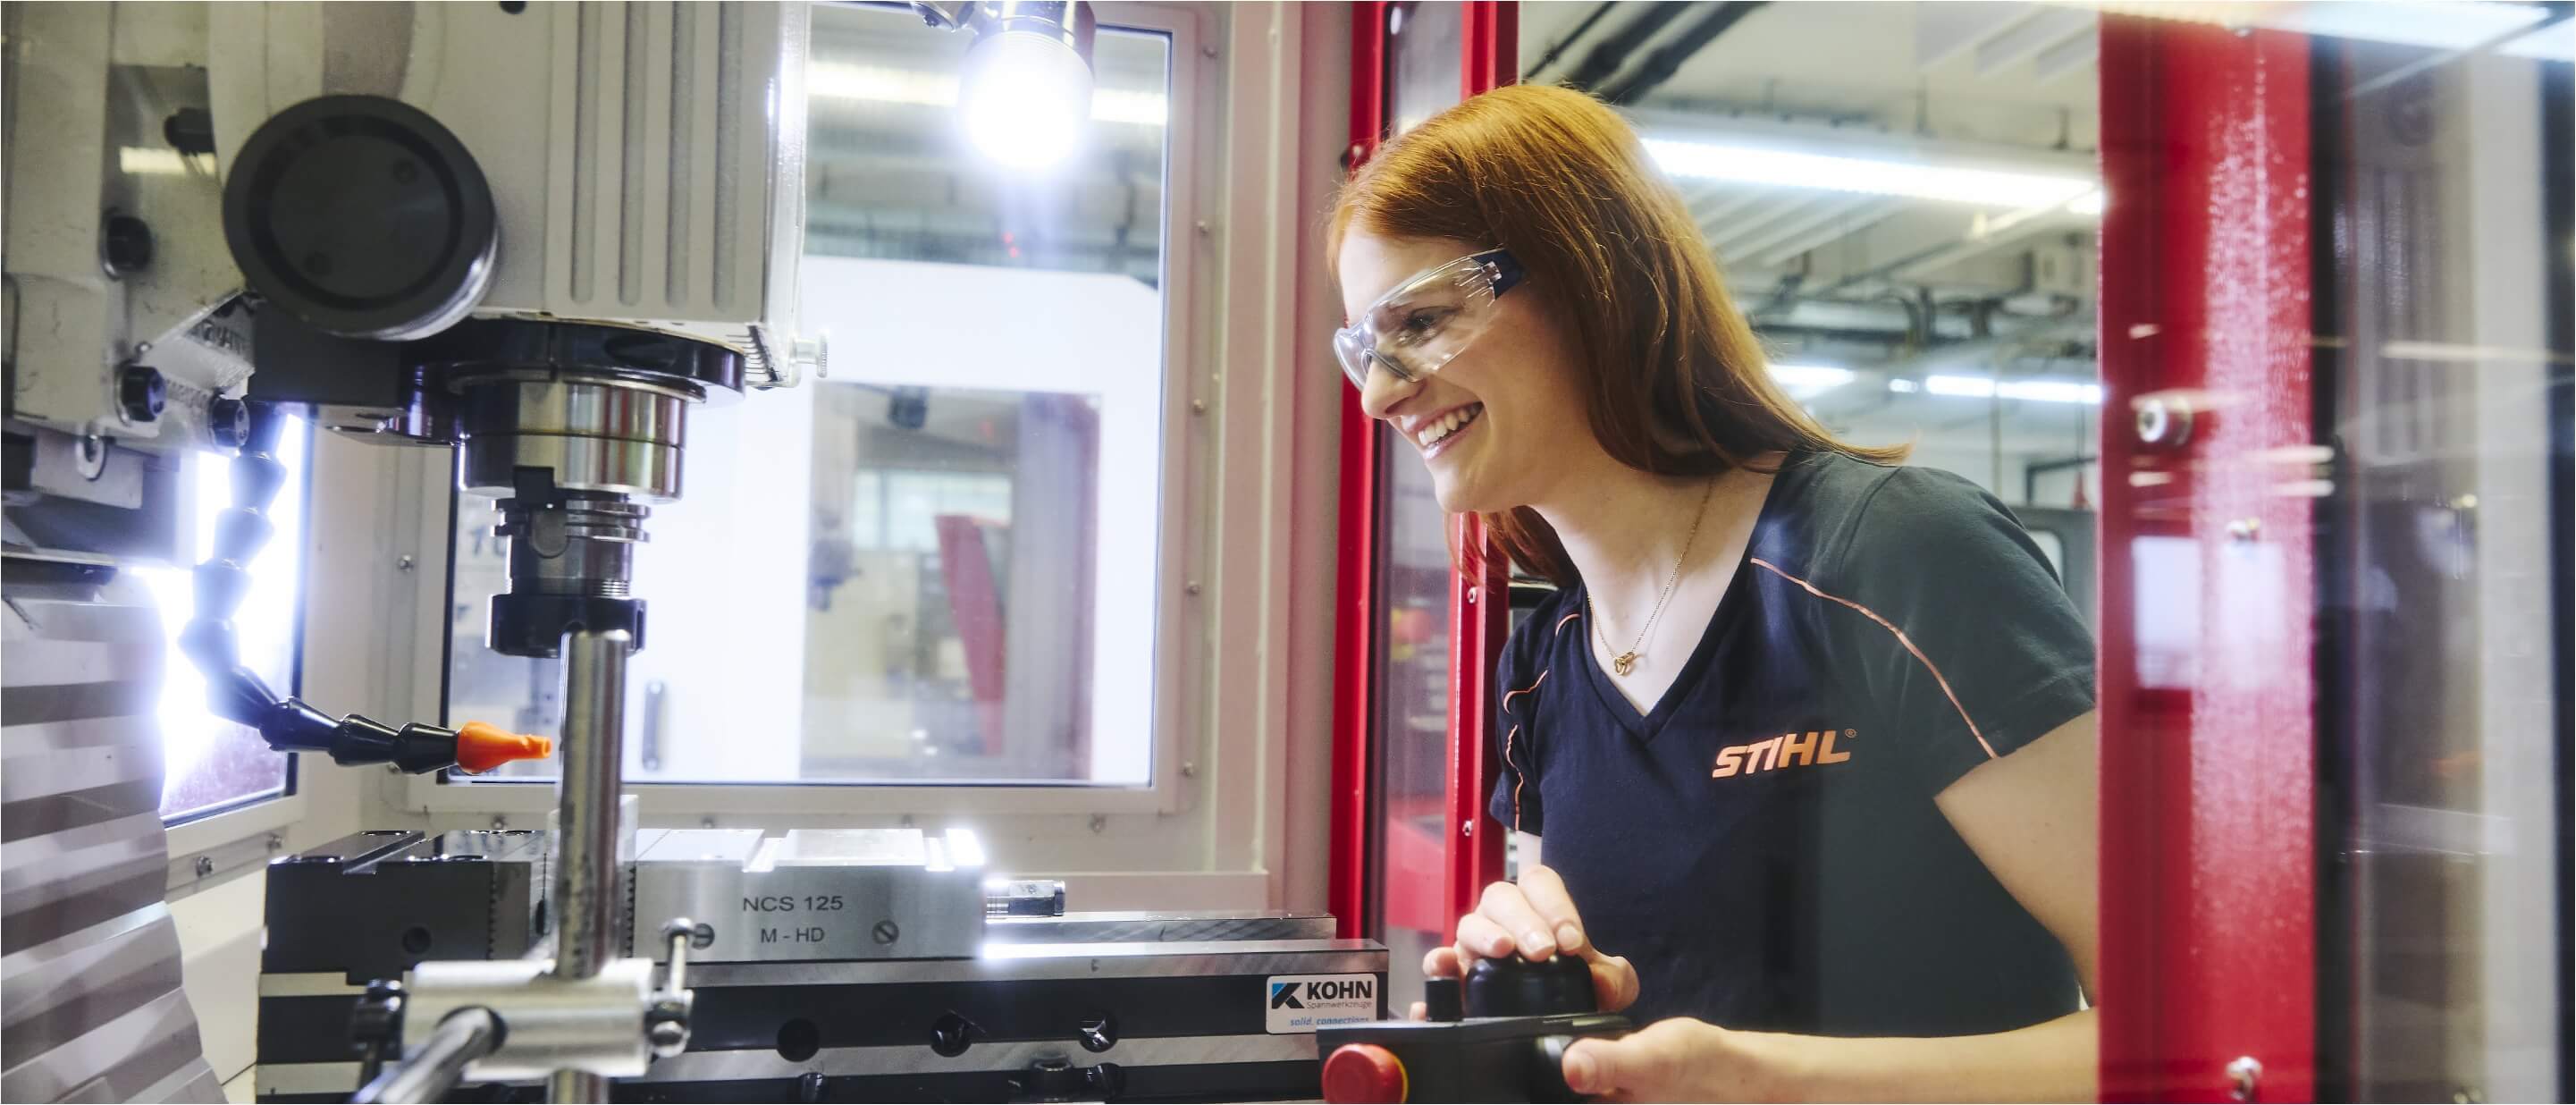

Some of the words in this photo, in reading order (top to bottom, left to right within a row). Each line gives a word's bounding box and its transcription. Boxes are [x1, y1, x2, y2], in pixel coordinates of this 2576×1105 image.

[1712, 730, 1851, 779] STIHL
[743, 896, 795, 912] NCS
[804, 895, 844, 911] 125
[760, 928, 778, 943] M
[796, 926, 825, 943] HD
[1307, 980, 1372, 1000] KOHN
